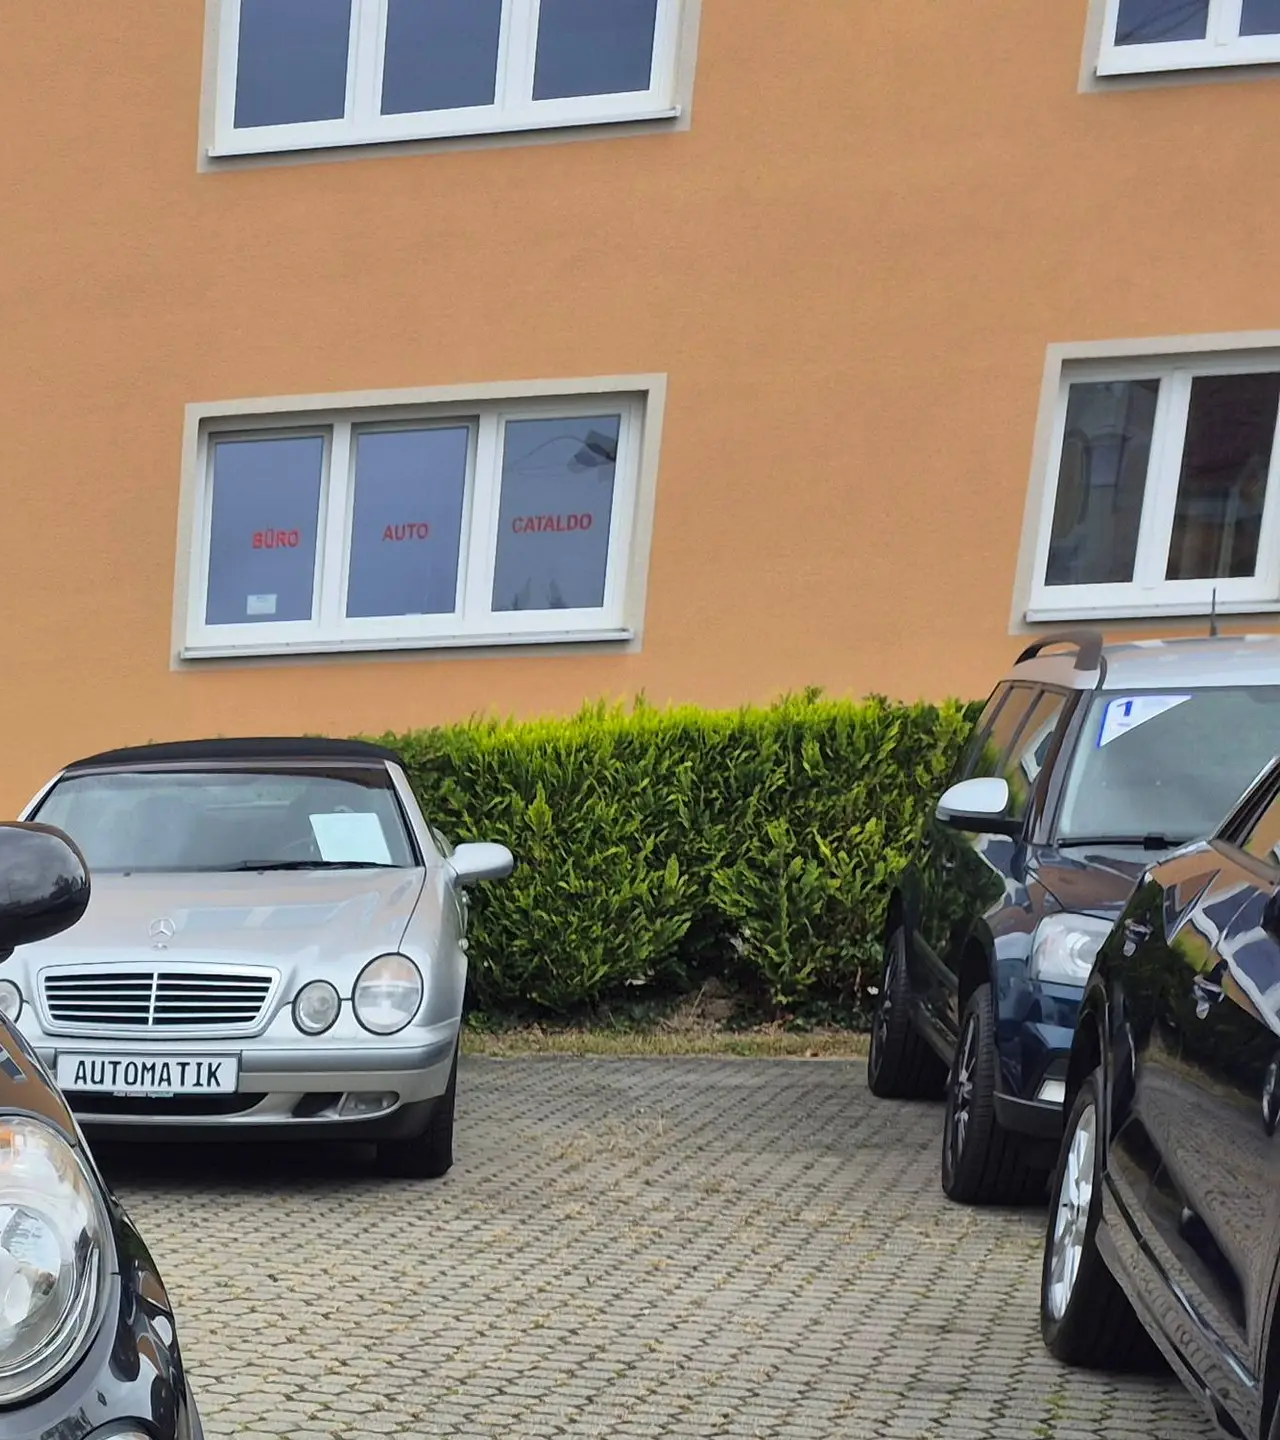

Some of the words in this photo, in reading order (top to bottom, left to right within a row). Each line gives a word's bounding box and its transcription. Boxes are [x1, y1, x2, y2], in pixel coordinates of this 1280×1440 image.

[251, 528, 300, 550] BÜRO
[382, 521, 429, 543] AUTO
[511, 512, 592, 535] CATALDO
[73, 1060, 222, 1088] AUTOMATIK
